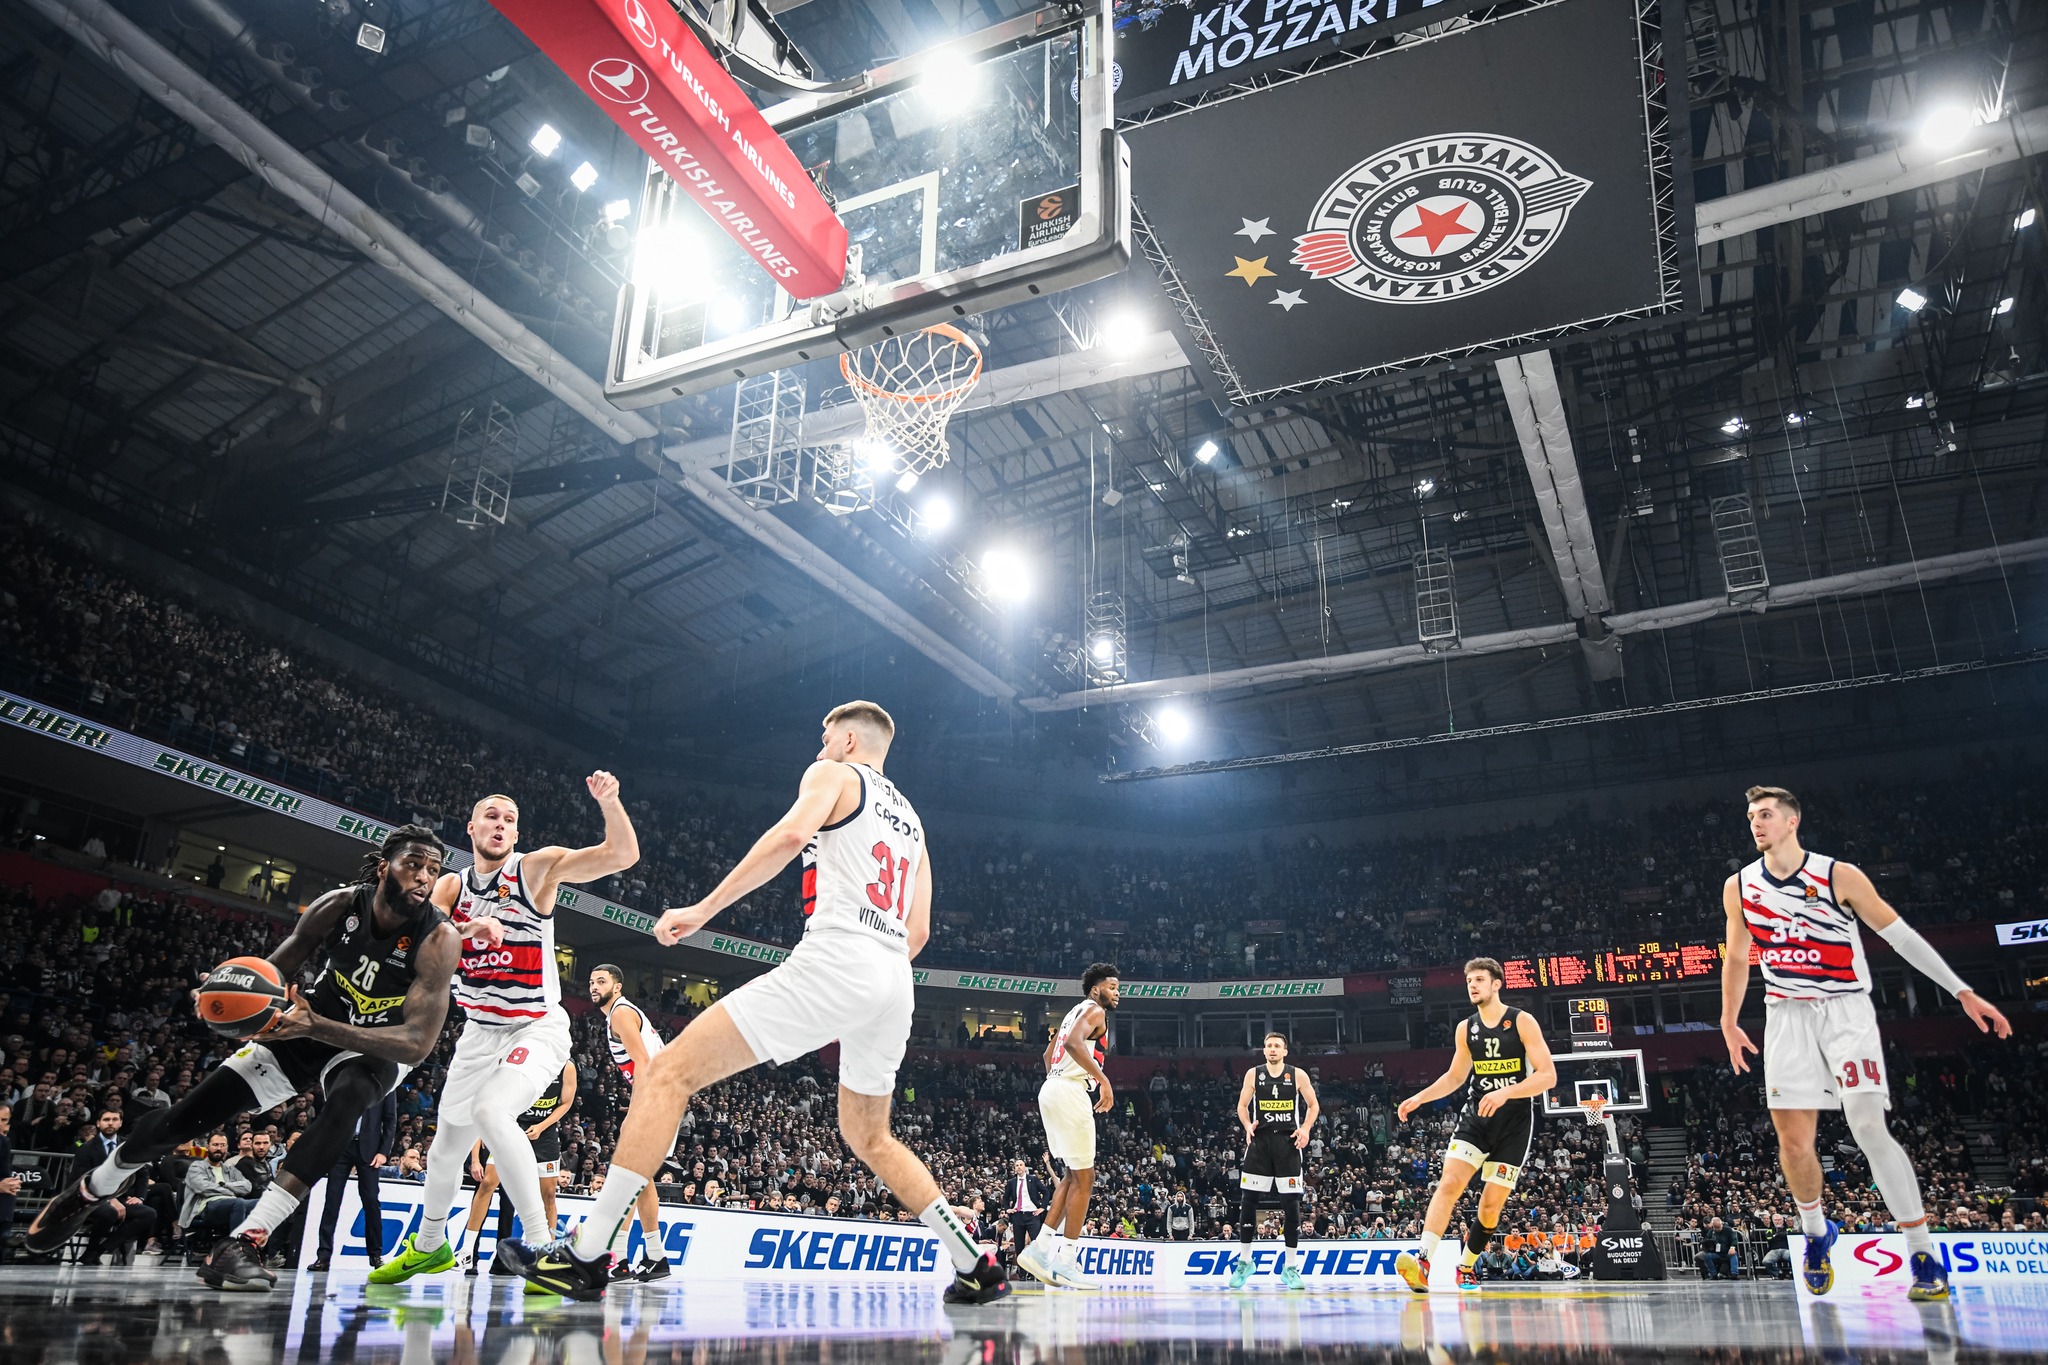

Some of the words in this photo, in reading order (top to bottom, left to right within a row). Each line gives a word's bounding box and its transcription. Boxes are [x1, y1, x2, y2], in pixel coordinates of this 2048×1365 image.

[1189, 0, 1249, 46] KK
[660, 38, 729, 132] TURKISH
[732, 130, 795, 209] AIRLINES
[629, 102, 724, 197] TURKISH
[712, 196, 799, 278] AIRLINES
[1324, 143, 1541, 220] ПАРТИЗАН
[1438, 178, 1487, 194] CLUB
[1374, 185, 1420, 218] KLUB
[1029, 214, 1071, 233] TURKISH
[1029, 222, 1072, 241] AIRLINES
[1459, 188, 1510, 263] BASKETBALL
[1362, 220, 1442, 273] KOŠARKAŠKI
[1354, 228, 1551, 298] PARTIZAN
[874, 801, 920, 843] CAZOO
[865, 840, 910, 921] 31
[1767, 916, 1808, 944] 34
[350, 954, 380, 992] 26
[1623, 960, 1637, 970] 47
[1645, 959, 1652, 968] 2
[1663, 957, 1676, 968] 34
[1618, 974, 1624, 983] 2
[1627, 973, 1638, 982] 04
[1650, 971, 1662, 981] 23
[1577, 1000, 1605, 1013] 2:08
[1595, 1016, 1608, 1033] 8
[506, 1047, 530, 1065] 8
[1484, 1037, 1502, 1058] 32
[1476, 1060, 1518, 1072] MOZZART
[1842, 1058, 1881, 1089] 34
[1271, 1084, 1279, 1100] 4
[1260, 1101, 1293, 1109] MOZZART
[1275, 1112, 1292, 1122] NIS
[744, 1228, 940, 1273] SKECHERS
[1620, 1237, 1644, 1249] NIS
[1985, 1260, 2011, 1273] NA
